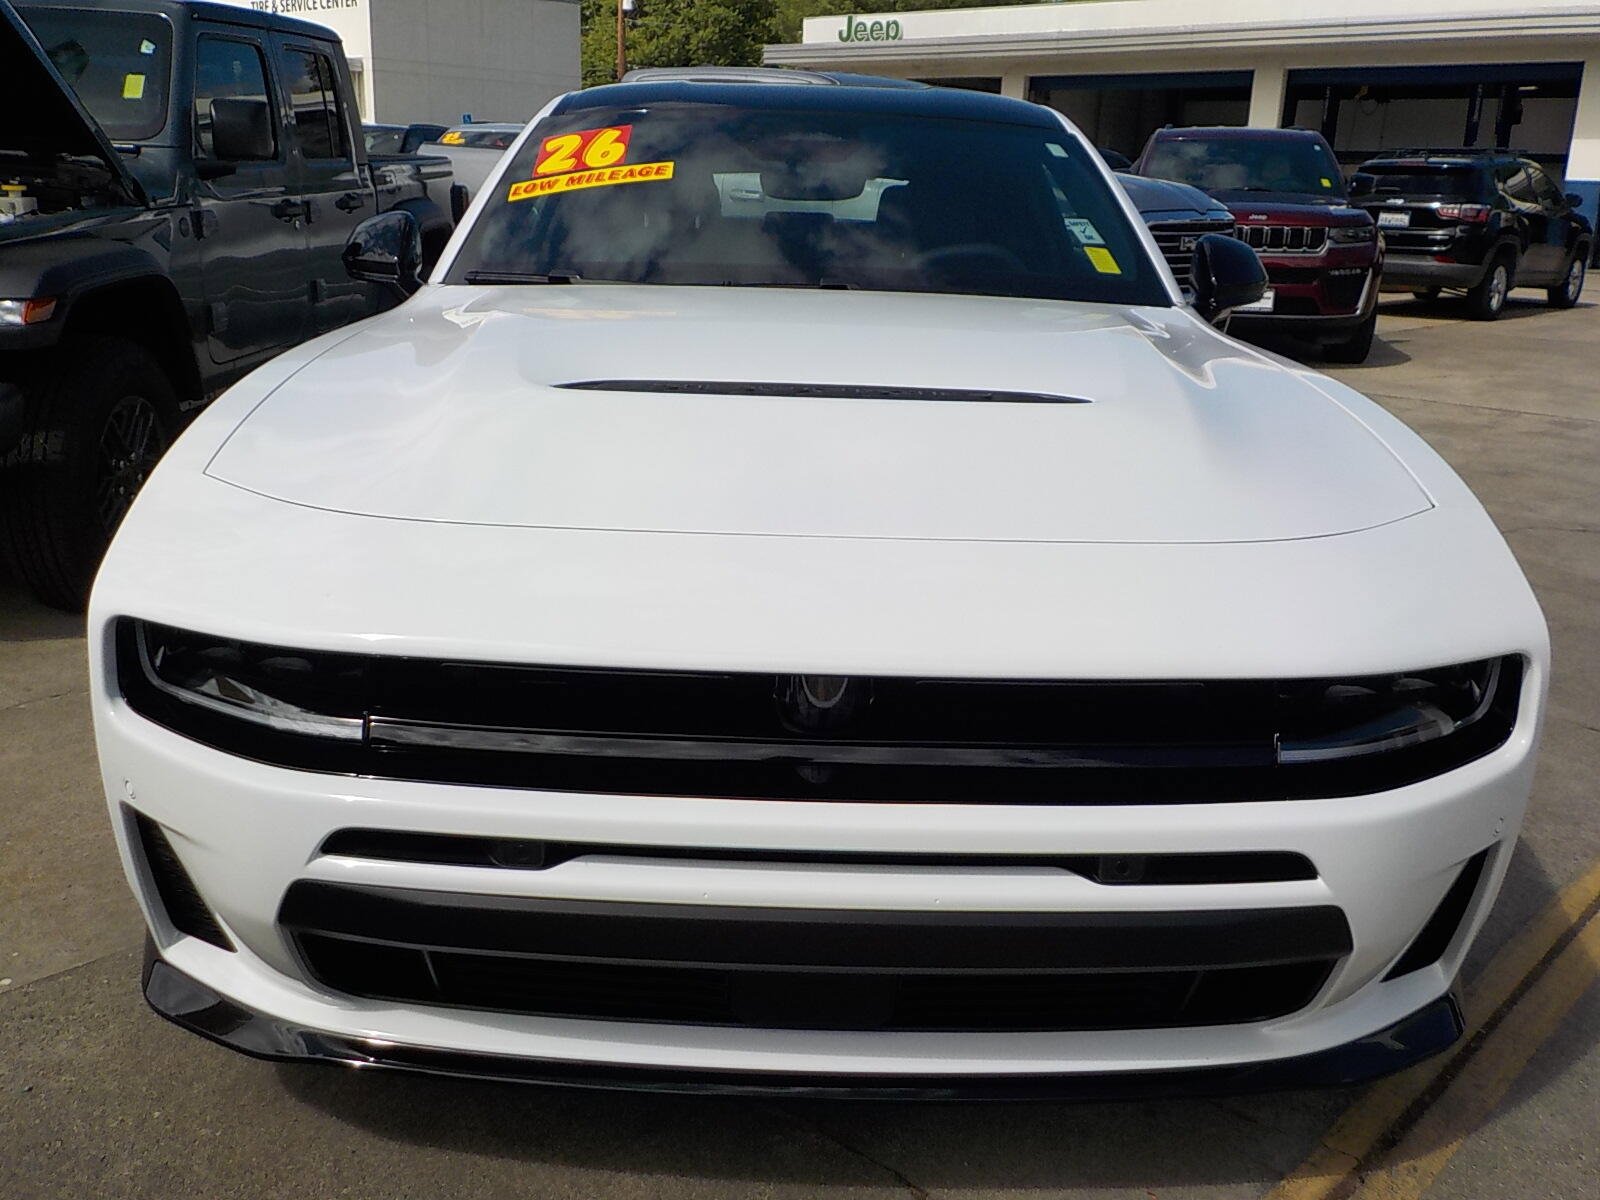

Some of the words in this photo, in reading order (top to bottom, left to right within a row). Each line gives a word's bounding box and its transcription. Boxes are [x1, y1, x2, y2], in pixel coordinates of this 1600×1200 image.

[250, 1, 269, 11] TIRE
[271, 1, 279, 13] &
[280, 0, 318, 13] SERVICE
[320, 0, 358, 9] CENTER
[838, 15, 901, 42] Jeep
[536, 128, 627, 175] 26
[511, 178, 561, 197] LOW
[565, 164, 671, 188] MILEAGE
